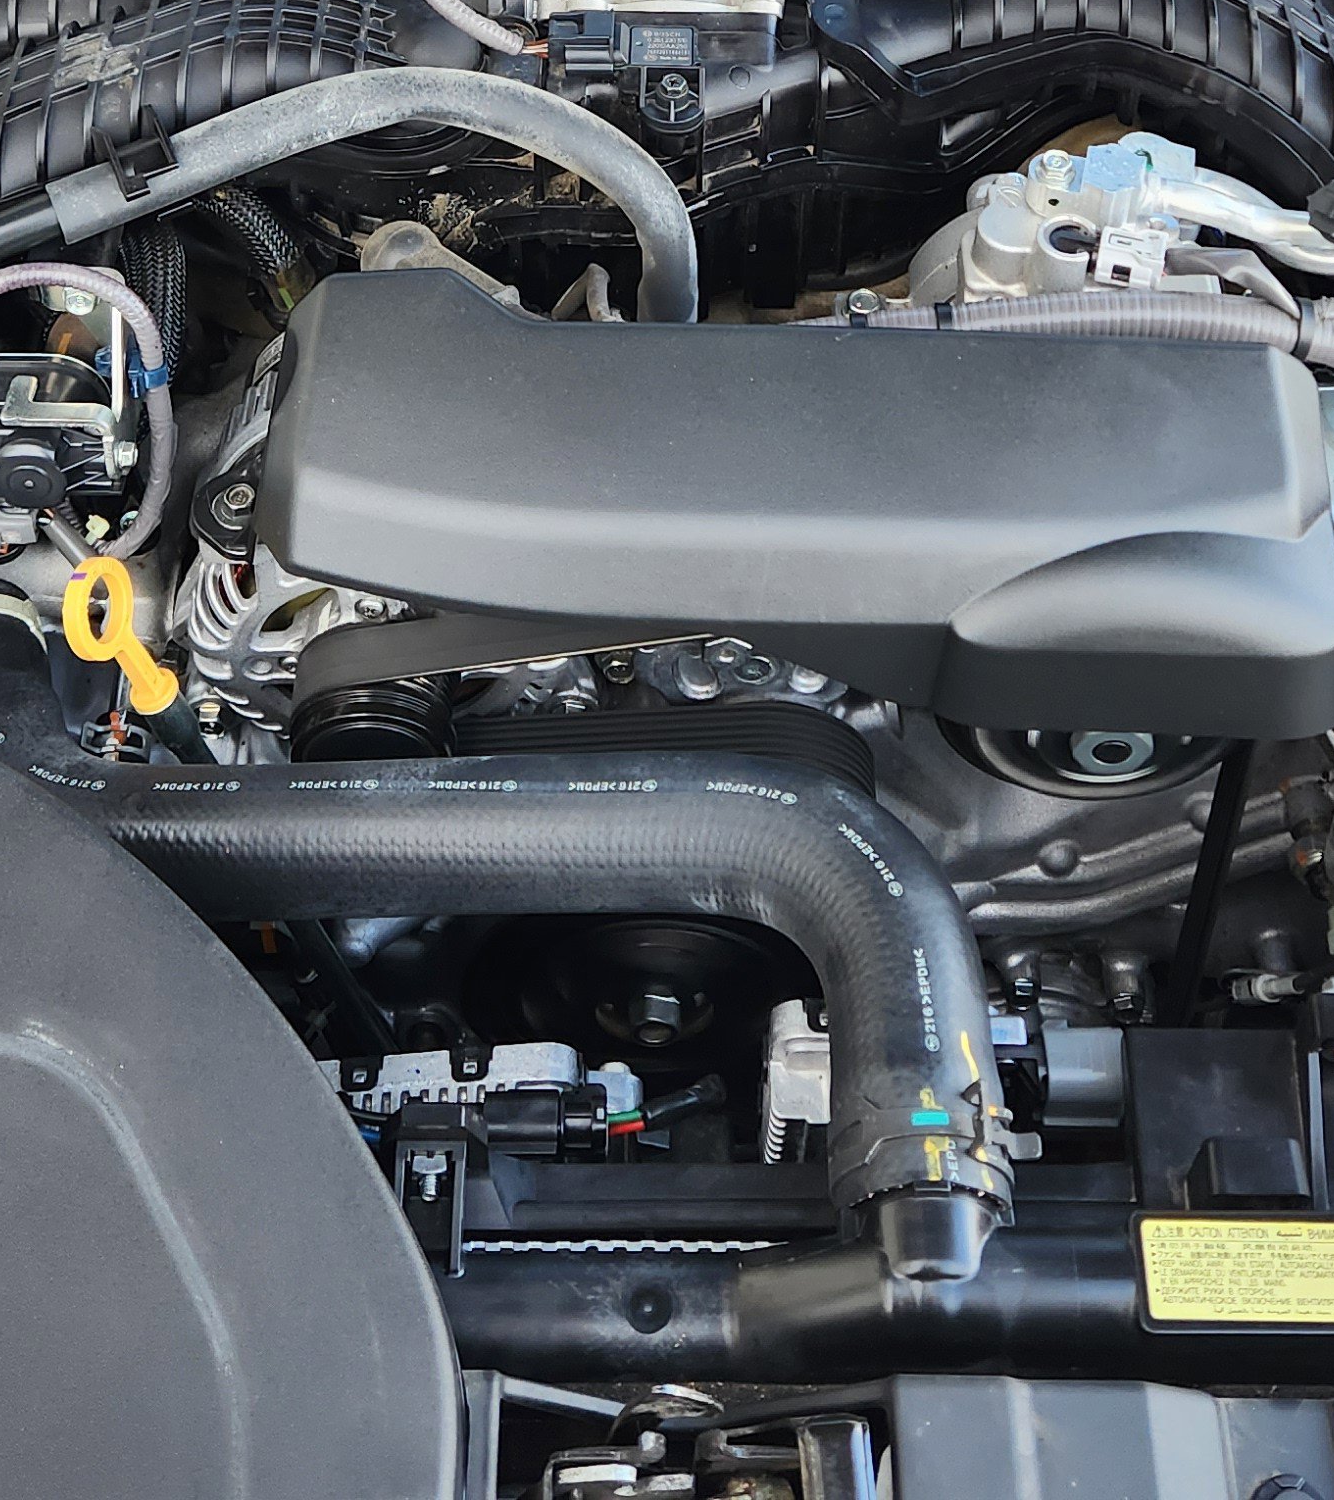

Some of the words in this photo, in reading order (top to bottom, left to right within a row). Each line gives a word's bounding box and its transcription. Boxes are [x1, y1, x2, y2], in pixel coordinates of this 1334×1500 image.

[945, 1139, 961, 1182] >EPD
[1188, 1226, 1223, 1238] CAUTION
[1228, 1227, 1269, 1239] ATTENTION
